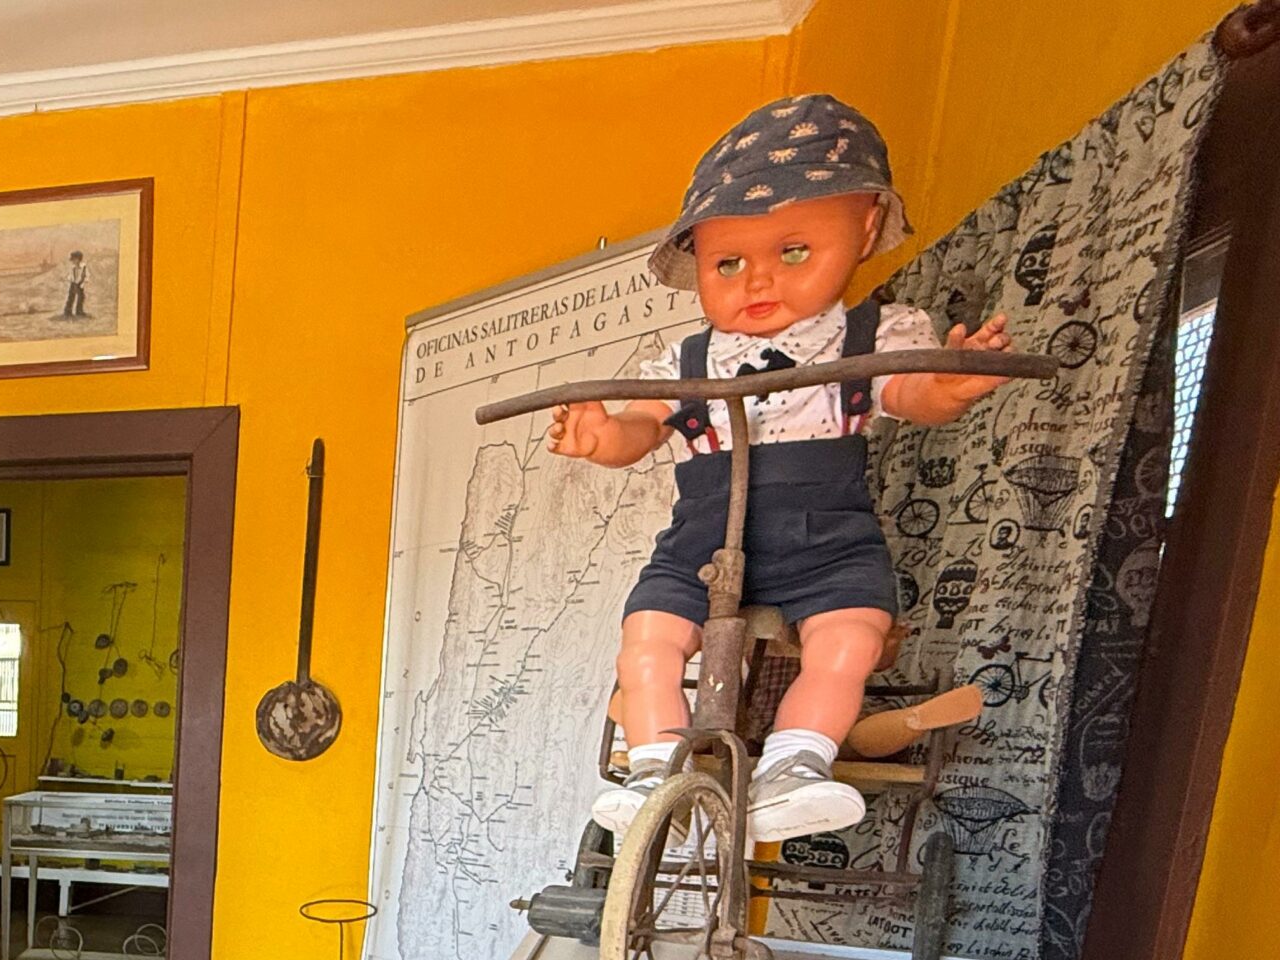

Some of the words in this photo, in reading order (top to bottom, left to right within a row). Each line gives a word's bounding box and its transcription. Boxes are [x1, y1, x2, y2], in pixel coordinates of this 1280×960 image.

[416, 325, 478, 359] OFICINAS
[480, 296, 569, 340] SALITRERAS
[572, 287, 597, 312] DE
[600, 280, 621, 303] LA
[415, 361, 444, 384] DE
